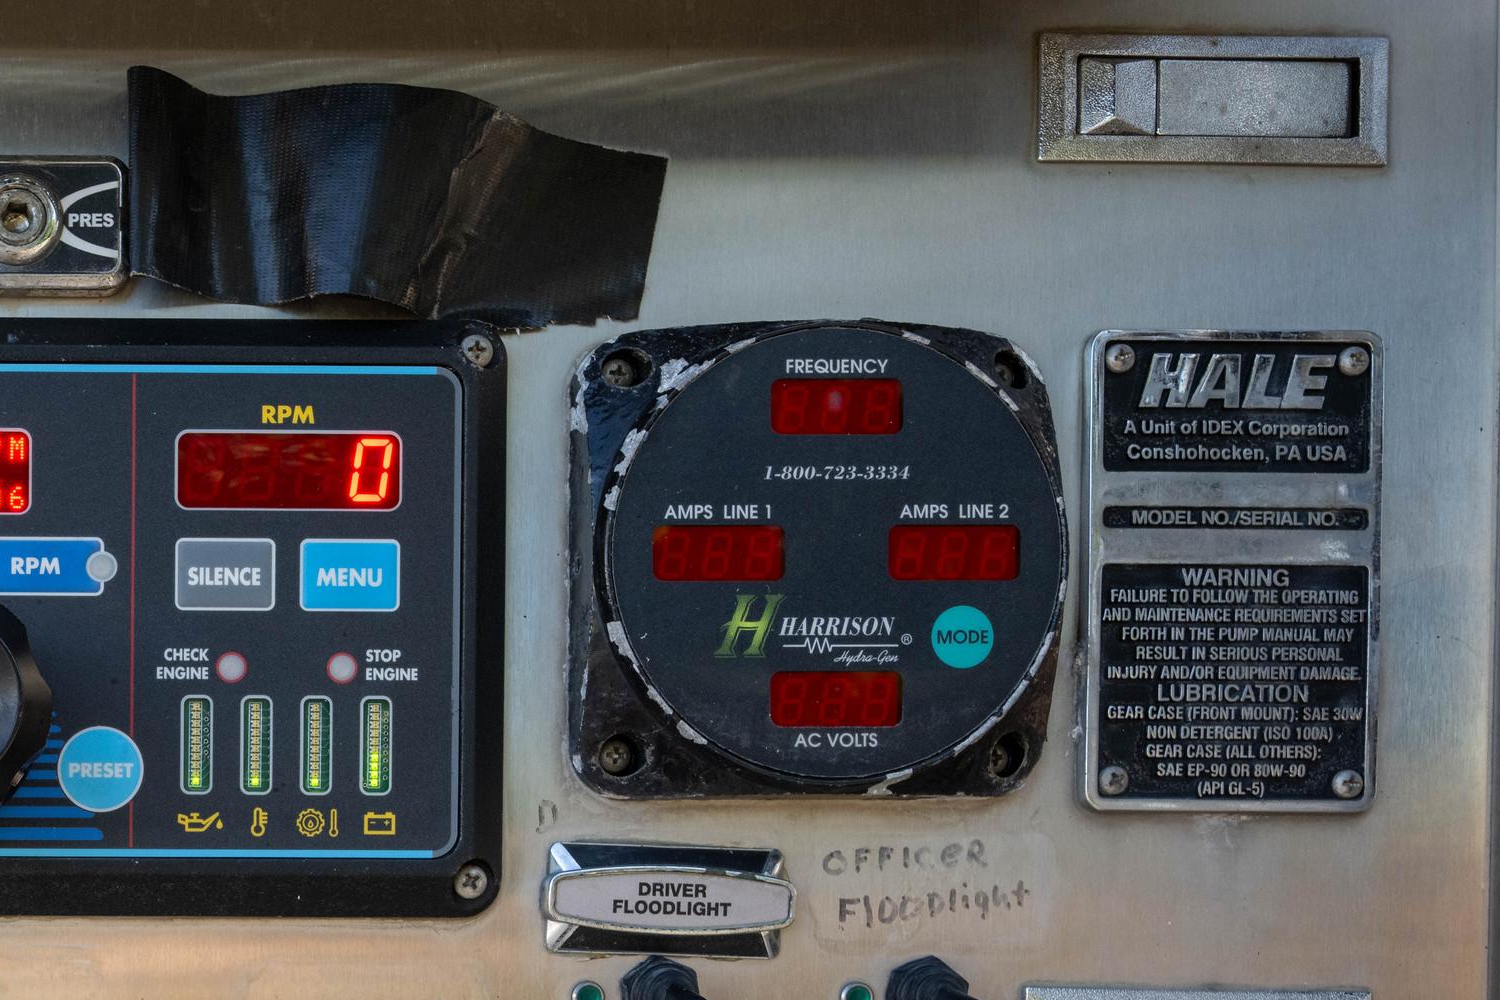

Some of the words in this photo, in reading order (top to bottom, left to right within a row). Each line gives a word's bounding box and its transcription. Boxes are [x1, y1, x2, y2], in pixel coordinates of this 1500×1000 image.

[68, 214, 114, 227] PRES
[785, 359, 888, 375] FREQUENCY
[1138, 353, 1336, 409] HALE
[262, 405, 315, 424] RPM
[1124, 420, 1136, 433] A
[1142, 421, 1174, 434] Unit
[1181, 420, 1197, 434] of
[1203, 421, 1243, 435] IDEX
[1248, 421, 1348, 438] Corporation
[1127, 445, 1269, 463] Conshohocken,
[1276, 446, 1300, 460] PA
[1307, 446, 1346, 461] USA
[349, 439, 392, 502] 0
[764, 466, 910, 480] 1-800-723-3334
[664, 505, 713, 519] AMPS
[724, 505, 759, 519] LINE
[766, 505, 772, 519] 1
[188, 567, 261, 586] SILENCE
[317, 568, 382, 587] MENU
[1182, 568, 1289, 587] WARNING
[1103, 608, 1131, 621] AND
[1135, 609, 1230, 622] MAINTENANCE
[1234, 609, 1337, 623] REQUIREMENTS
[1341, 610, 1366, 623] SET
[779, 617, 895, 637] HARRISON
[937, 629, 988, 644] MODE
[164, 649, 209, 661] CHECK
[834, 650, 899, 666] Hydra-Gen
[156, 667, 209, 680] ENGINE
[1158, 684, 1309, 702] LUBRICATION
[68, 761, 133, 778] PRESET
[1157, 764, 1182, 776] SAE
[1188, 764, 1227, 777] EP-90
[1231, 764, 1250, 777] OR
[1254, 764, 1306, 777] 80W-90
[639, 882, 707, 898] DRIVER
[612, 900, 731, 917] FLOODLIGHT
